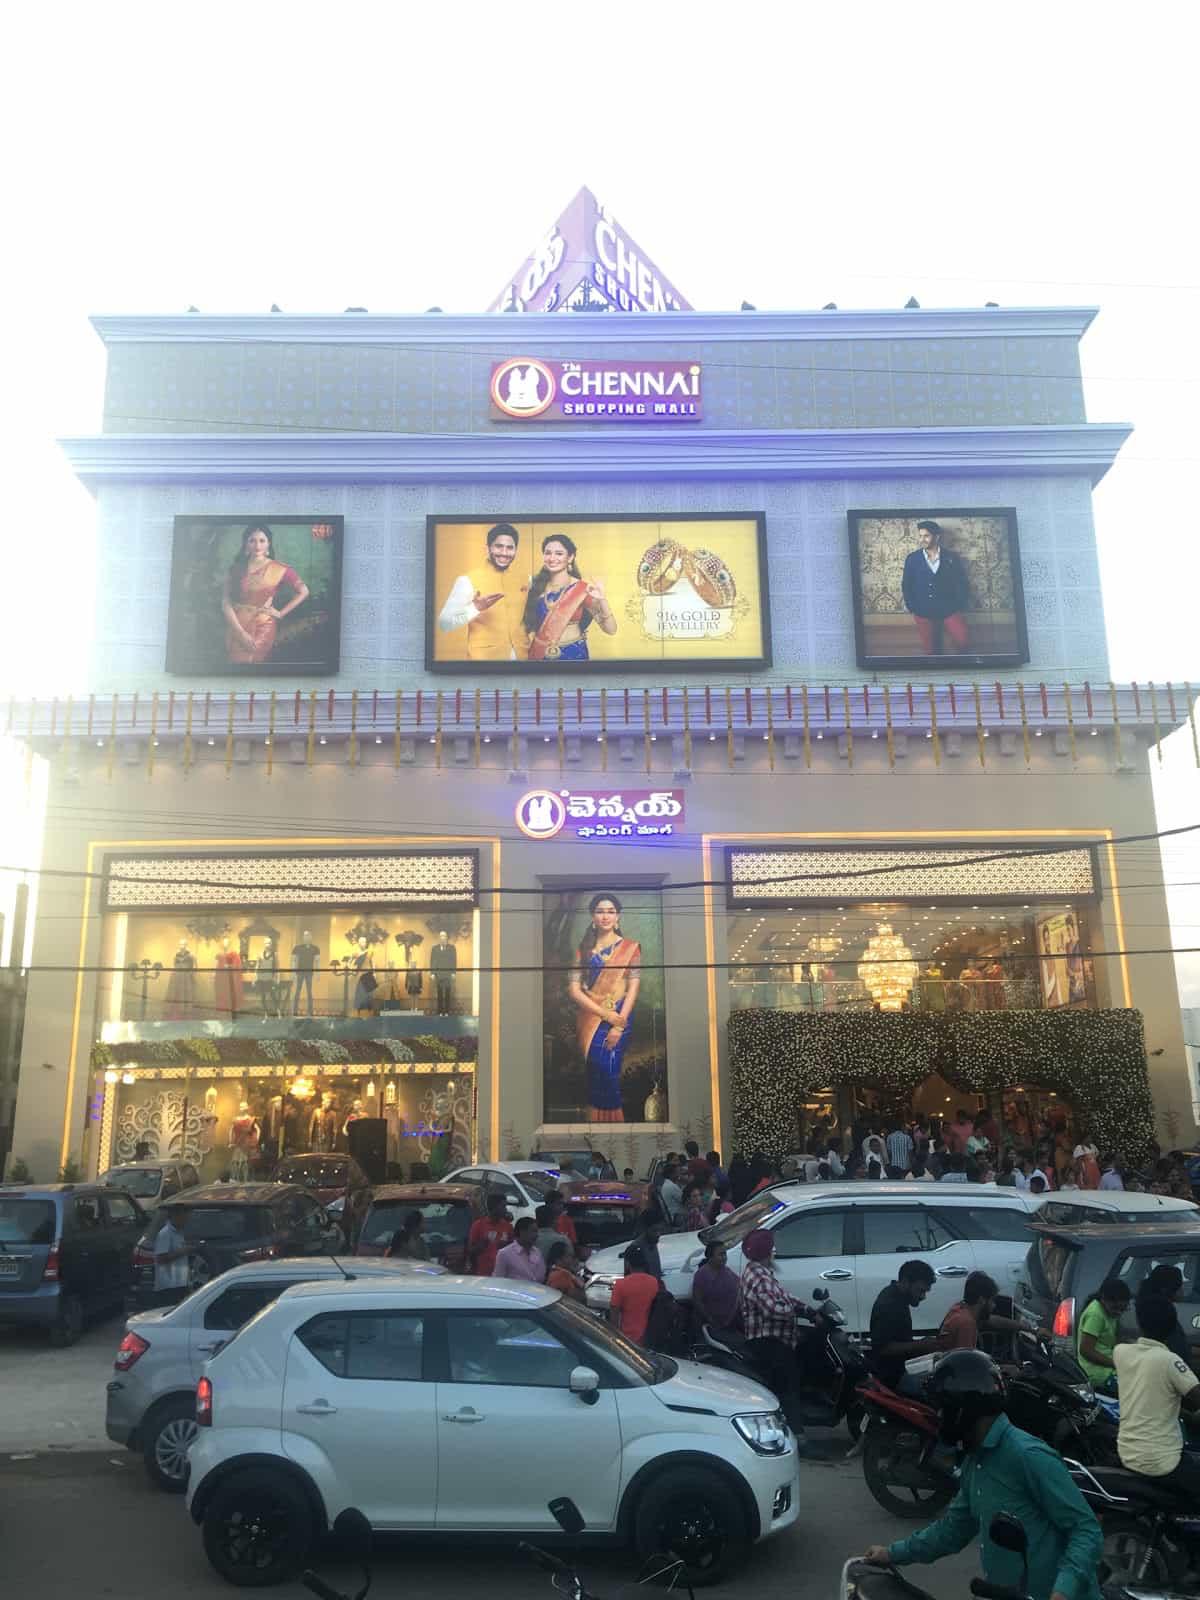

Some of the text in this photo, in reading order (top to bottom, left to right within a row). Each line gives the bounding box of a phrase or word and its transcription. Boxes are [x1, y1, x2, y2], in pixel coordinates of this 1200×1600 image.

[561, 362, 581, 372] The
[563, 402, 696, 415] SHOPPING MALL
[656, 610, 721, 621] 916 GOLD
[658, 621, 721, 632] JEWELLERY
